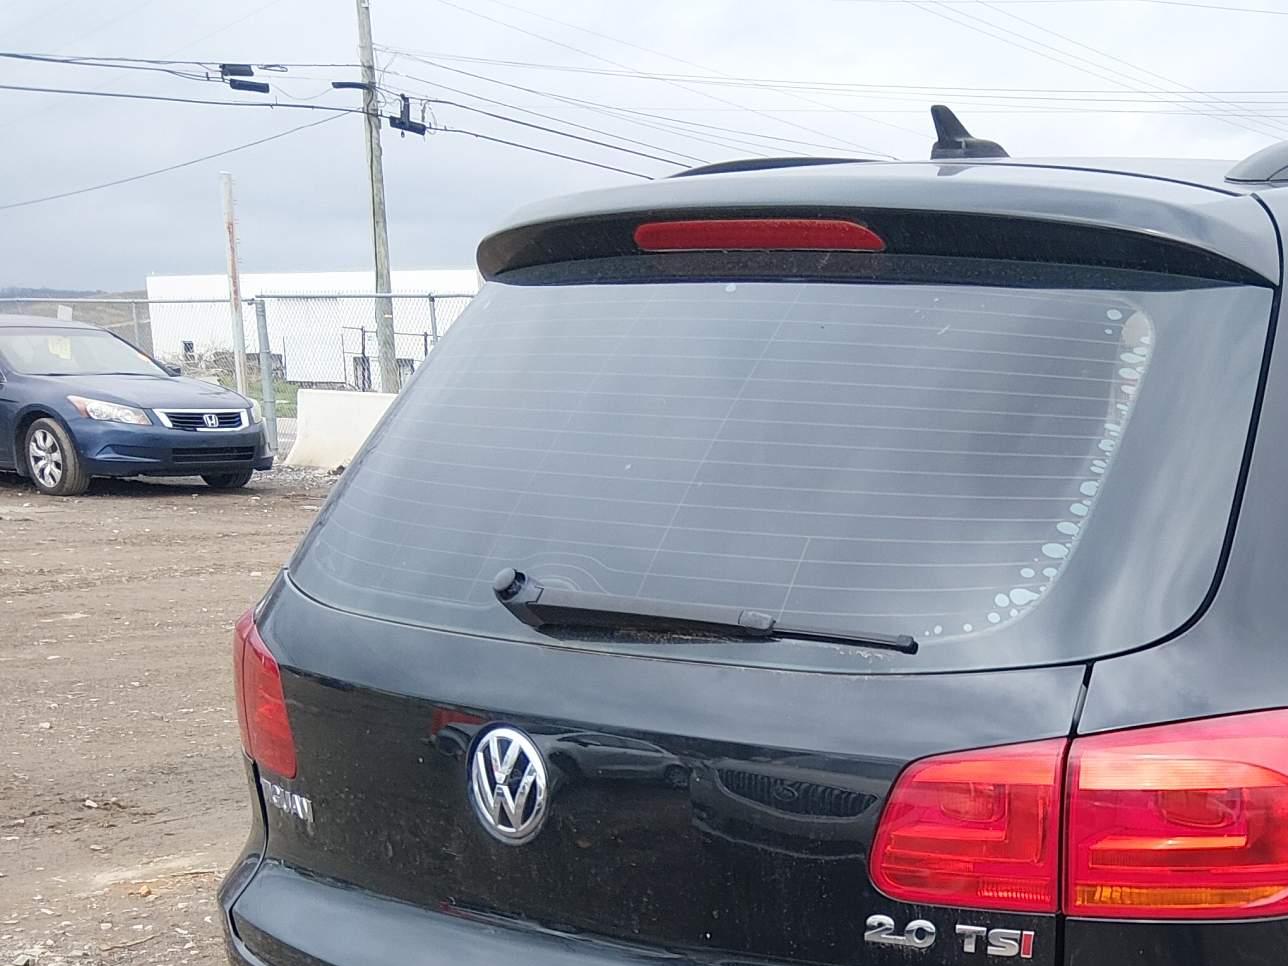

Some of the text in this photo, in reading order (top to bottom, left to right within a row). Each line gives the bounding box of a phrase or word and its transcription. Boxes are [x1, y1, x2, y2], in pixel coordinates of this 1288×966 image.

[470, 725, 547, 840] VW
[864, 914, 1035, 959] 2.0 TSI
